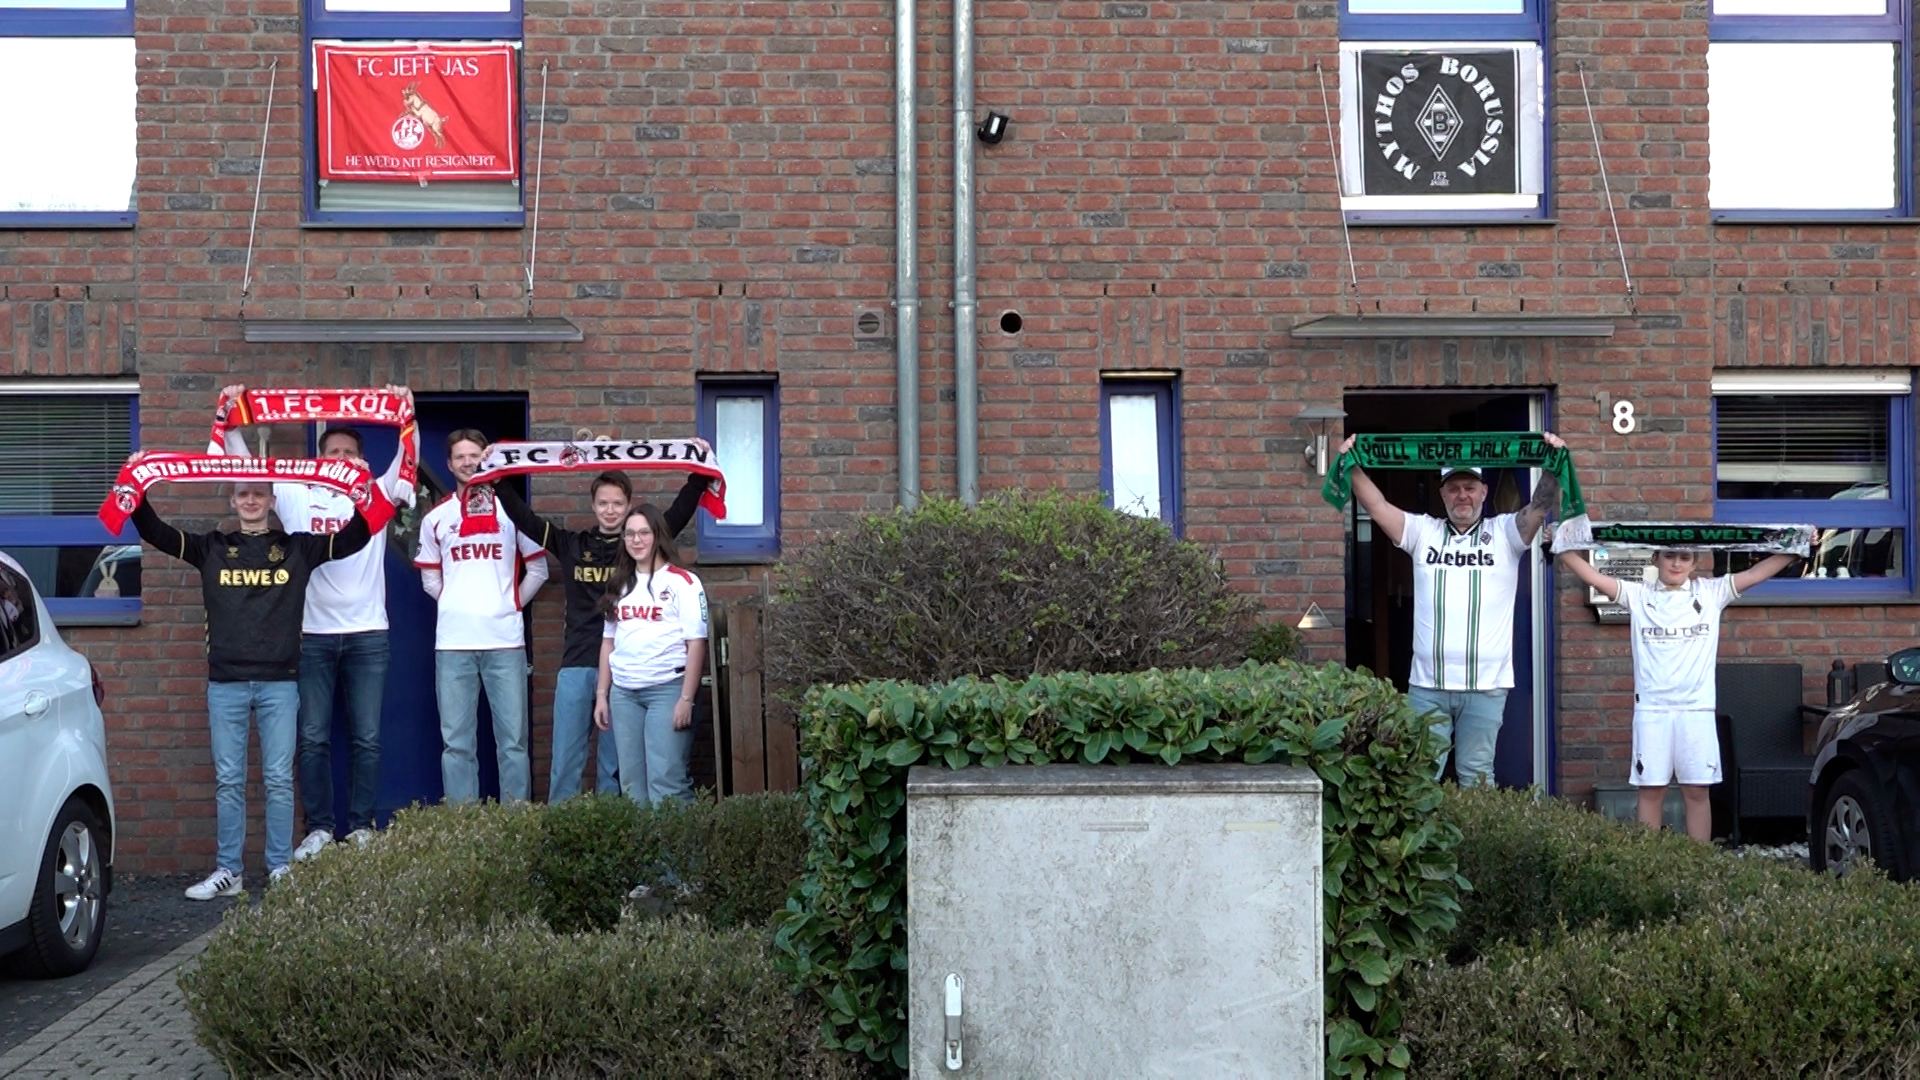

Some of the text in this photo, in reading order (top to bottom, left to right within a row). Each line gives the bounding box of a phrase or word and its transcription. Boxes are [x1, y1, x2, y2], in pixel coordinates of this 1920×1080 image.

[357, 55, 479, 76] FC JEFF JAS
[1374, 63, 1421, 181] MYTHOS
[1439, 56, 1504, 178] BORUSSIA
[345, 155, 362, 167] HE
[402, 157, 424, 168] NIT
[425, 155, 496, 168] RESIGNIERT
[284, 395, 323, 413] FC
[500, 448, 549, 465] FC
[593, 441, 707, 463] KÖLN
[1418, 441, 1462, 460] NEVER
[1470, 441, 1510, 458] WALK
[132, 459, 361, 485] ERSTER FUSSBALL CLUB KÖLN
[1701, 529, 1763, 540] WELT
[219, 569, 273, 586] REWE
